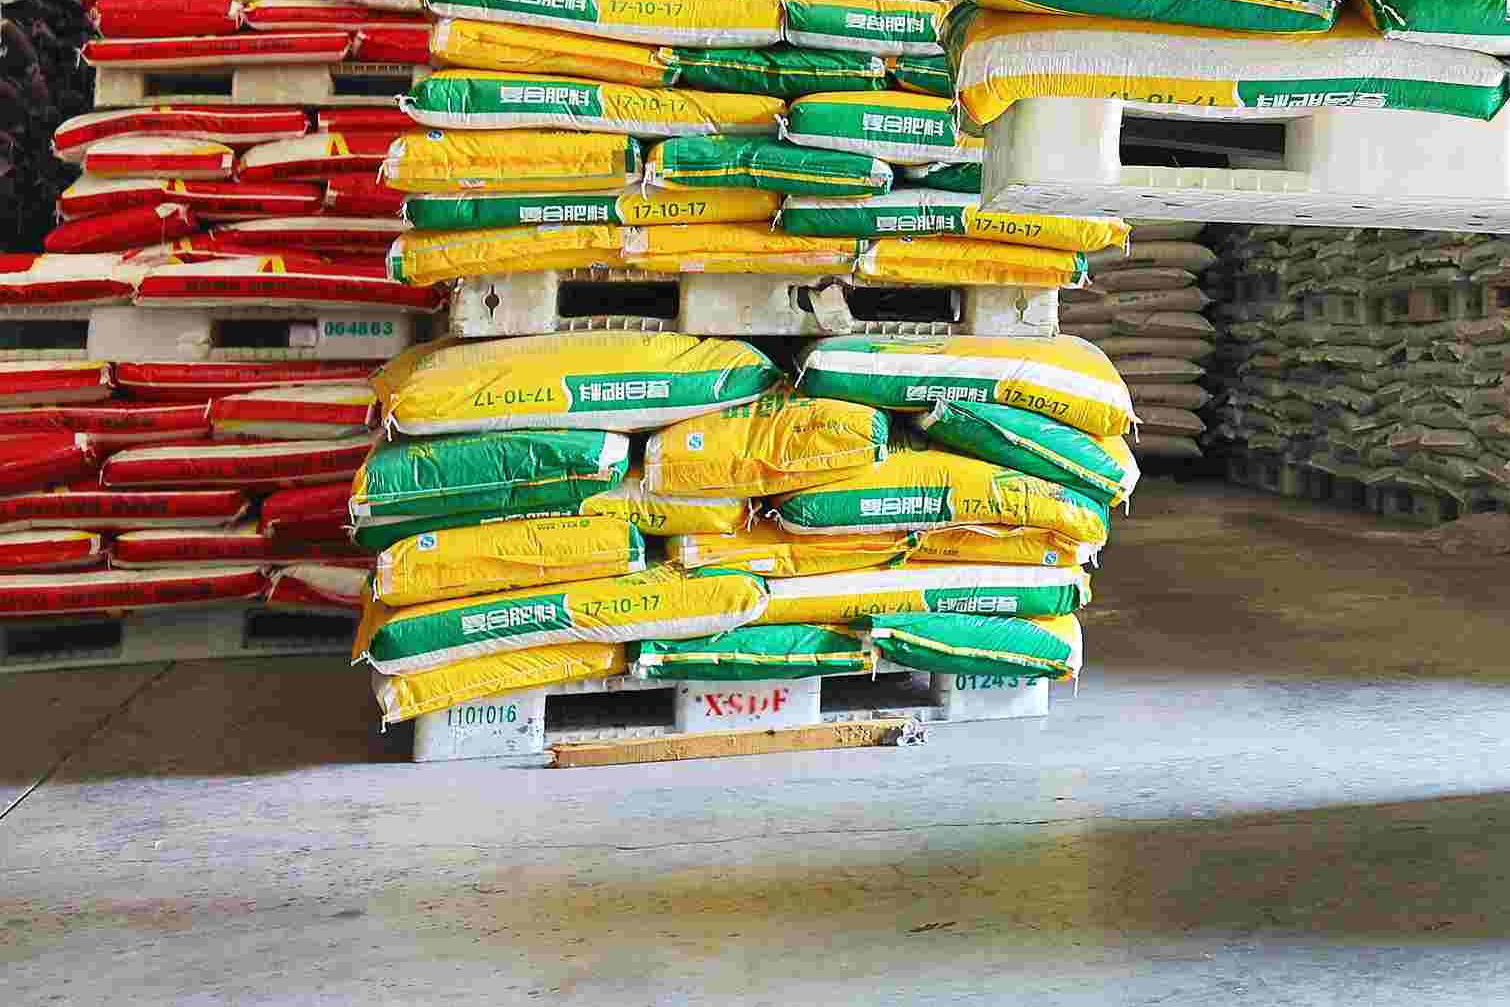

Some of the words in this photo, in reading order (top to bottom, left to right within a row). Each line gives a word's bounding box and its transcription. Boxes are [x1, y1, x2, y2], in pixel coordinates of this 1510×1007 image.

[609, 1, 683, 16] 17-10-17
[846, 12, 924, 32] 复合肥料
[501, 86, 590, 106] 复合肥料
[616, 94, 689, 112] 17-10-17
[863, 113, 944, 136] 复合肥料
[519, 205, 608, 223] 复合肥料
[633, 202, 706, 219] 17-10-17
[875, 214, 954, 232] 复合肥料
[974, 218, 1041, 236] 17-10-17
[473, 387, 555, 407] 17-10-17
[579, 379, 670, 402] 复合肥料
[906, 384, 987, 403] 复合肥料
[1003, 387, 1069, 416] 17-10-17
[861, 496, 942, 515] 复合肥料
[462, 604, 556, 634] 复合肥料
[584, 596, 660, 614] 17-10-17
[447, 705, 518, 726] 1101016
